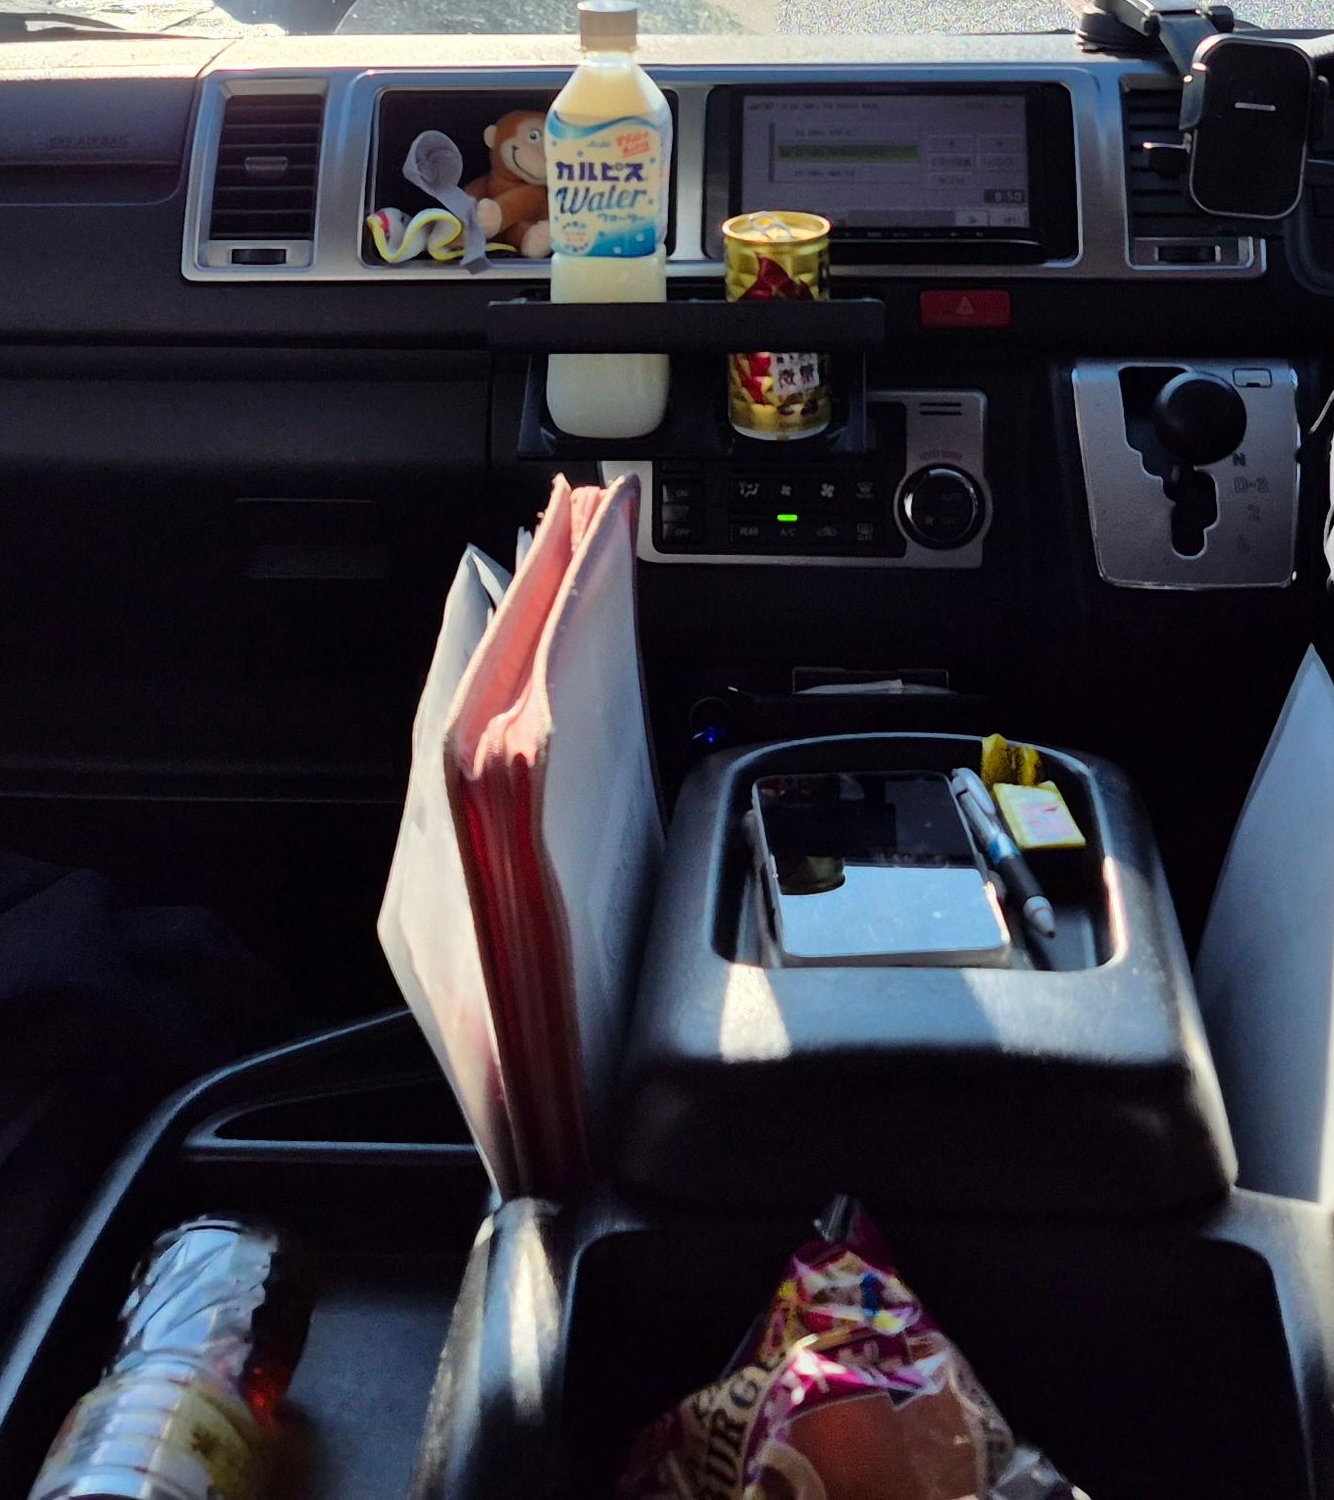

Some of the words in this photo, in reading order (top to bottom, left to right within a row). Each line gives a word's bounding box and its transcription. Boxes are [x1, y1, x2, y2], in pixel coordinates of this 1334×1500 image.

[555, 161, 644, 182] カルピス
[555, 184, 648, 215] Water
